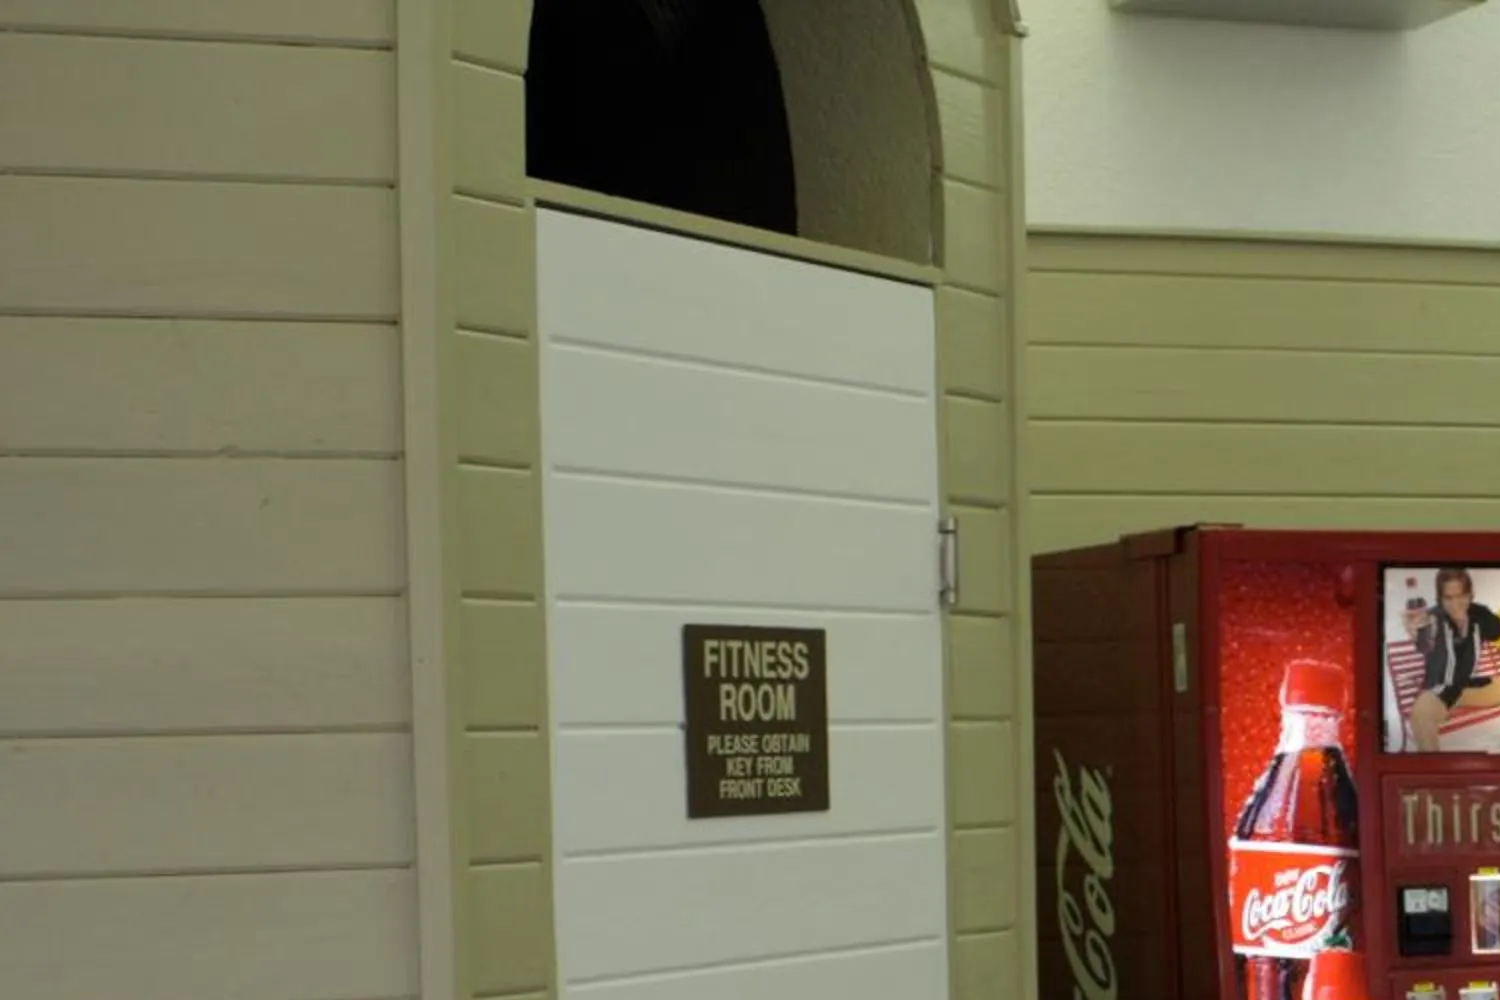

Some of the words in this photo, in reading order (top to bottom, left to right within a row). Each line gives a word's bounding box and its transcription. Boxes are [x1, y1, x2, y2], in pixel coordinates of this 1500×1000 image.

[703, 639, 810, 679] FITNESS
[719, 683, 797, 721] ROOM
[707, 734, 760, 755] PLEASE
[762, 733, 810, 754] OBTAIN
[726, 756, 753, 777] KEY
[757, 756, 794, 776] FROM
[719, 778, 764, 799] FRONT
[766, 777, 802, 797] DESK
[1242, 860, 1349, 940] Coca-Cola
